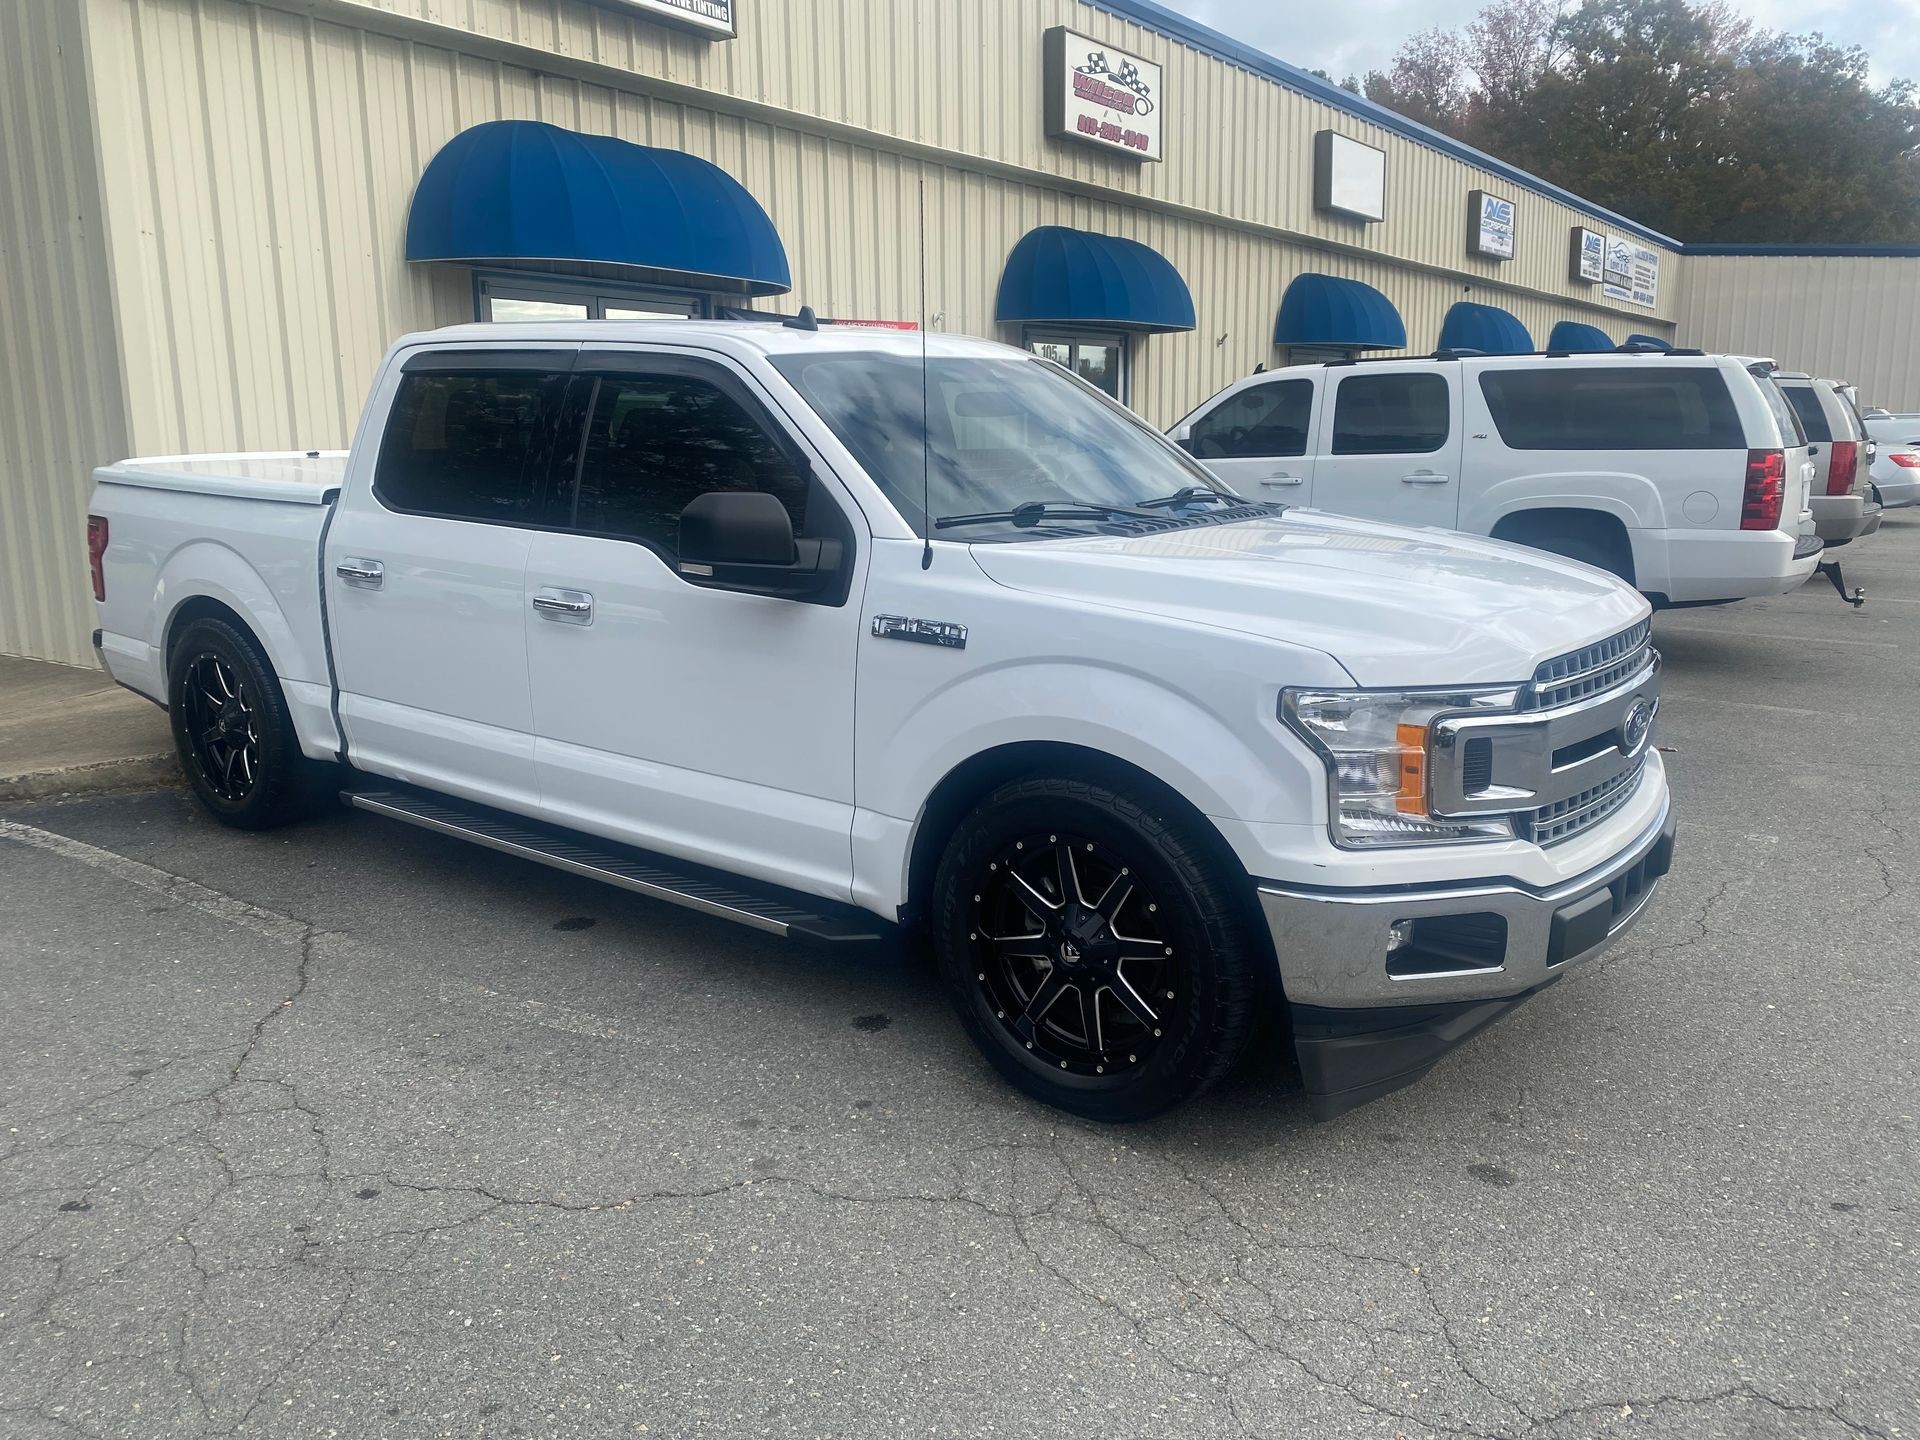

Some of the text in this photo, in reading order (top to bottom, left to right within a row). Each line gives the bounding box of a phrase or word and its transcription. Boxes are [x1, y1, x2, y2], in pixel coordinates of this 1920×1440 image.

[694, 0, 728, 21] TINTING
[1041, 344, 1058, 360] 105
[938, 637, 957, 646] XLT
